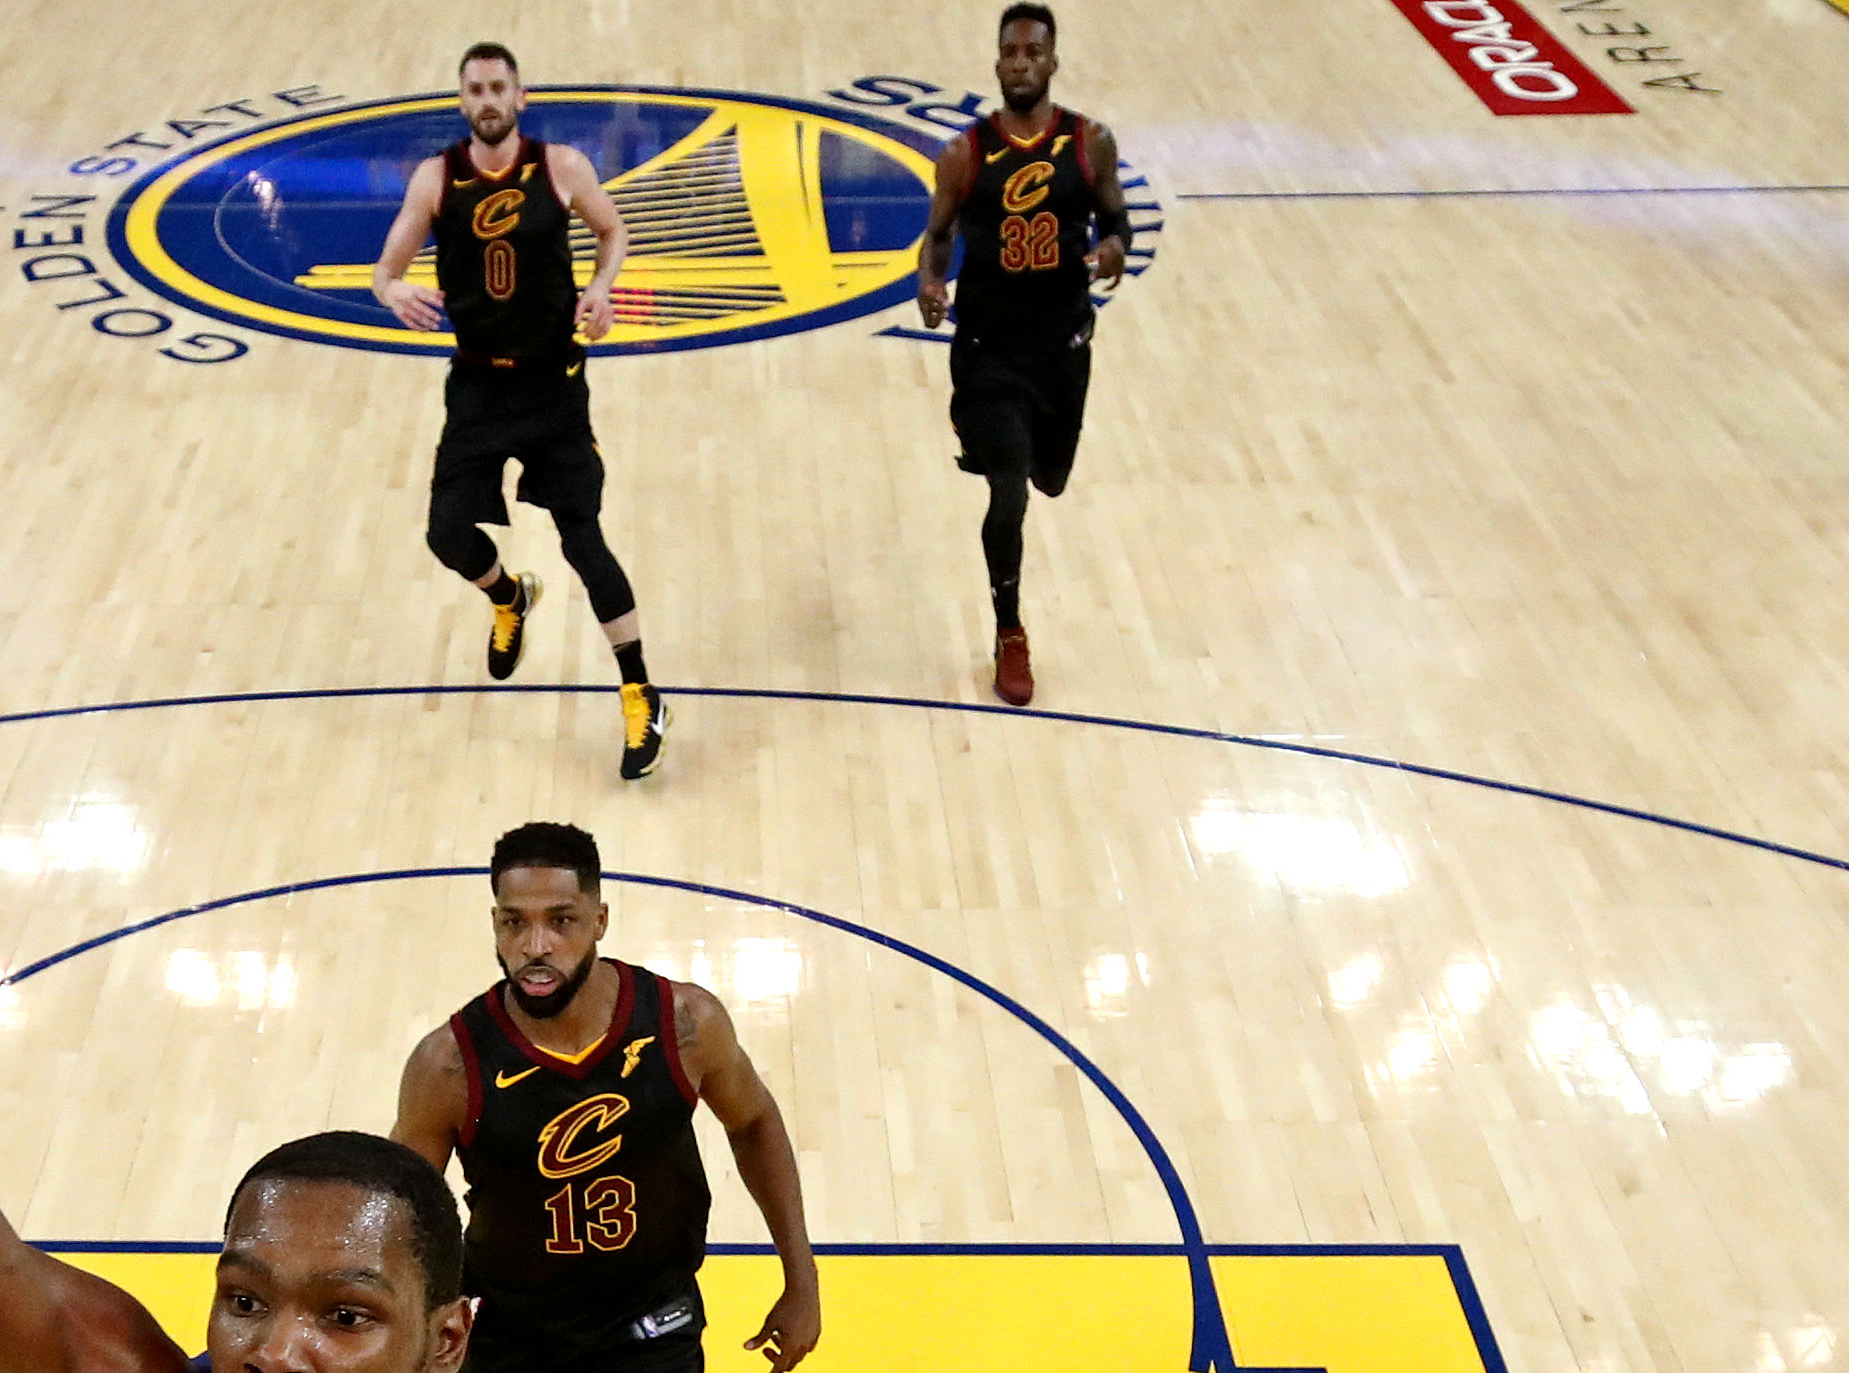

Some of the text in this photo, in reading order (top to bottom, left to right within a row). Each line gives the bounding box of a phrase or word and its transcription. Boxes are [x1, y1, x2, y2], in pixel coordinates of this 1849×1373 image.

[1422, 0, 1579, 101] ORAC
[13, 84, 345, 365] GOLDEN STATE
[1000, 211, 1059, 273] 32
[485, 239, 516, 299] 0
[544, 1175, 637, 1254] 13
